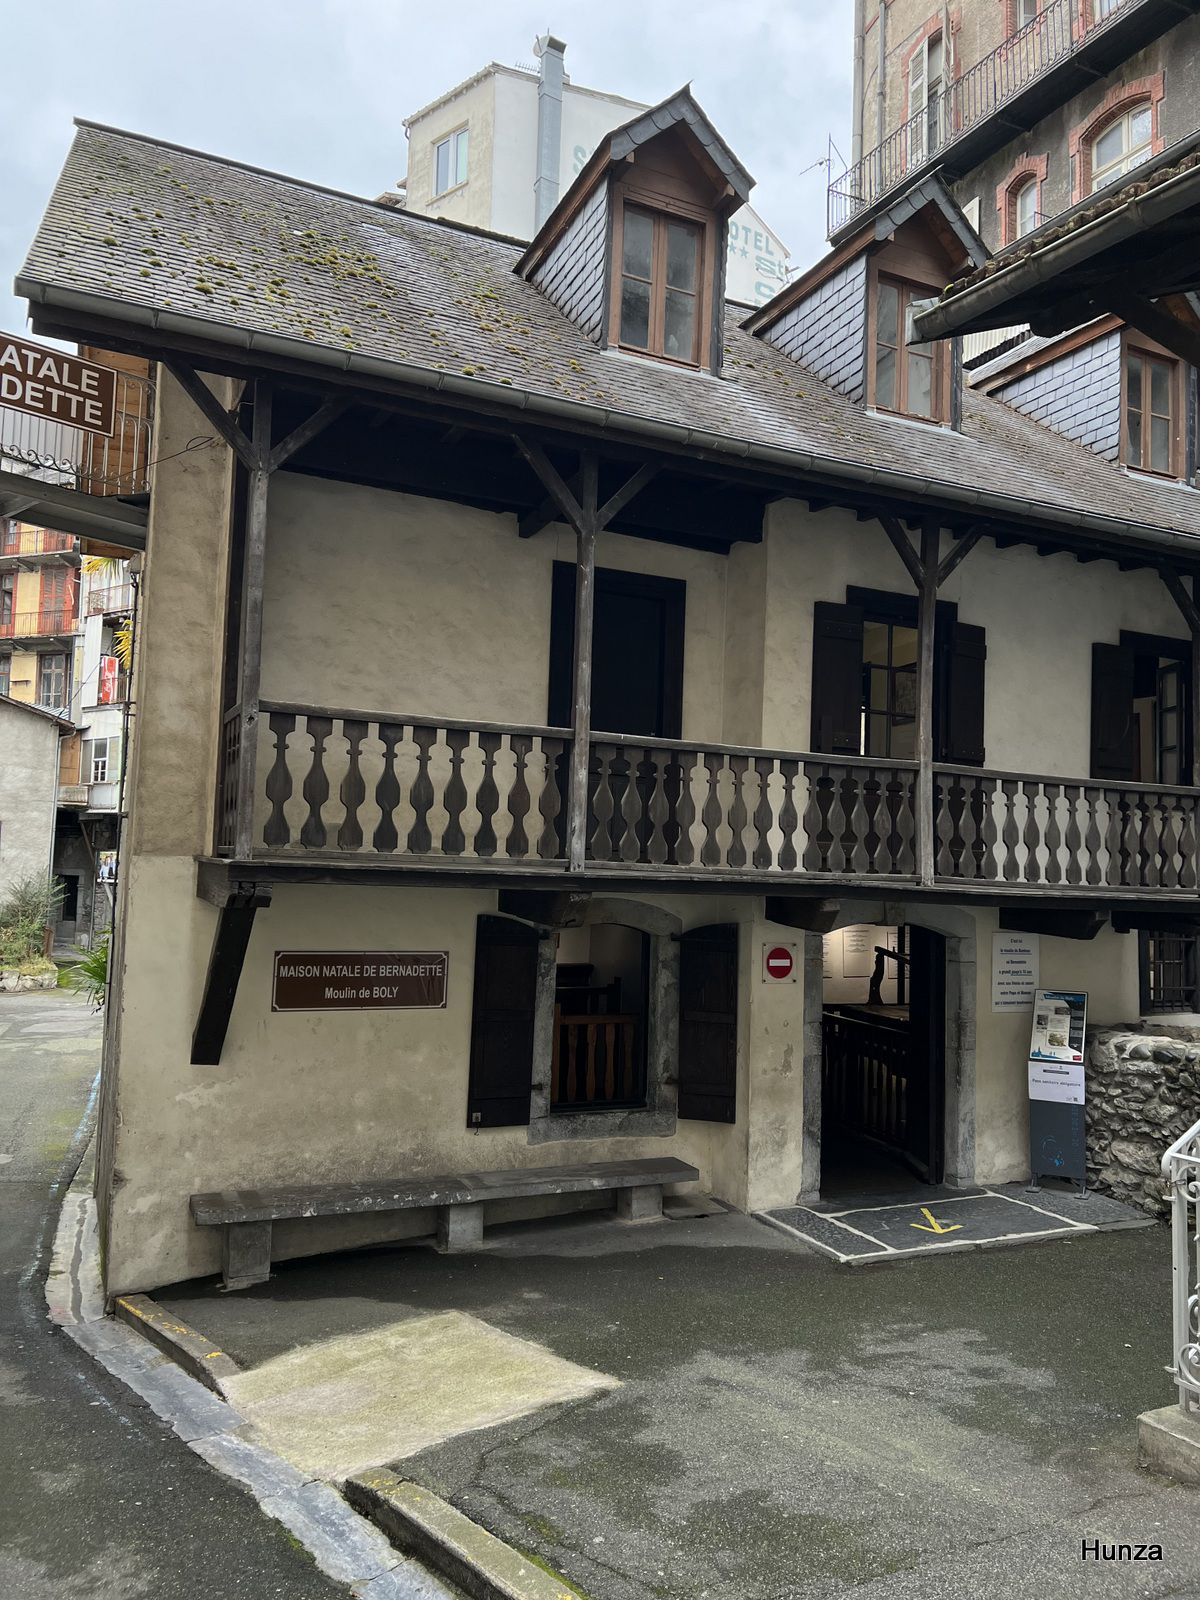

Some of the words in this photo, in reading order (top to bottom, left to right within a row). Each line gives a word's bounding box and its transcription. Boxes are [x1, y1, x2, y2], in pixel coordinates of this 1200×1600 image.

[1, 373, 102, 426] DETTE
[279, 965, 320, 978] MAISON
[322, 965, 361, 977] NATALE
[363, 965, 377, 977] DE
[379, 965, 443, 977] BERNADETTE
[324, 987, 356, 999] Moulin
[359, 987, 371, 998] de
[372, 986, 399, 998] BOLY
